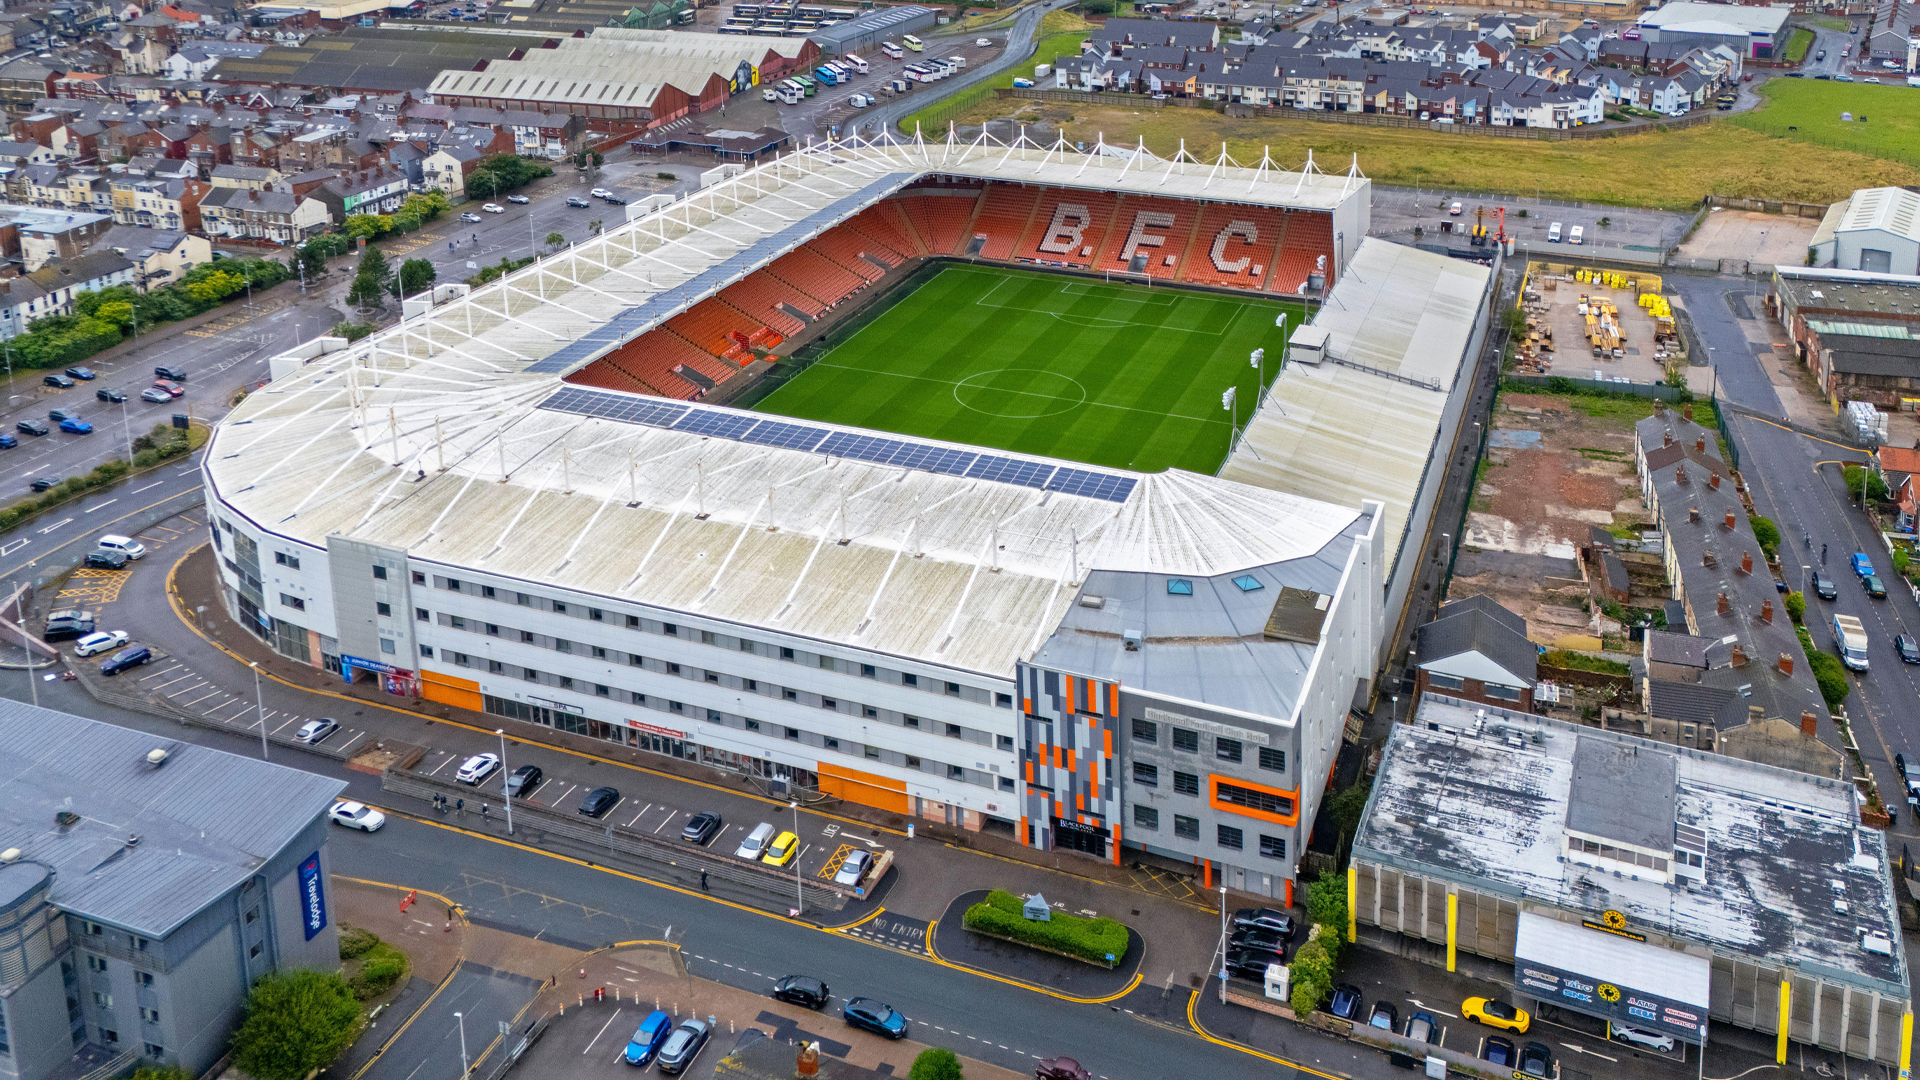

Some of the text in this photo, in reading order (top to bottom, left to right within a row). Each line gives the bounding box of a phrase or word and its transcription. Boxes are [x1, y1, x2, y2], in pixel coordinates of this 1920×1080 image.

[553, 702, 568, 711] SPA
[821, 823, 840, 839] EXIT
[1060, 819, 1096, 832] BLACKPOOL
[307, 873, 322, 930] Travelodge
[872, 918, 926, 940] NO ENTRY
[1562, 988, 1593, 1003] SNK
[1637, 1000, 1658, 1011] ATARI
[1628, 1006, 1657, 1021] SEGA
[1666, 1008, 1697, 1020] Nintendo
[1663, 1015, 1697, 1030] namco
